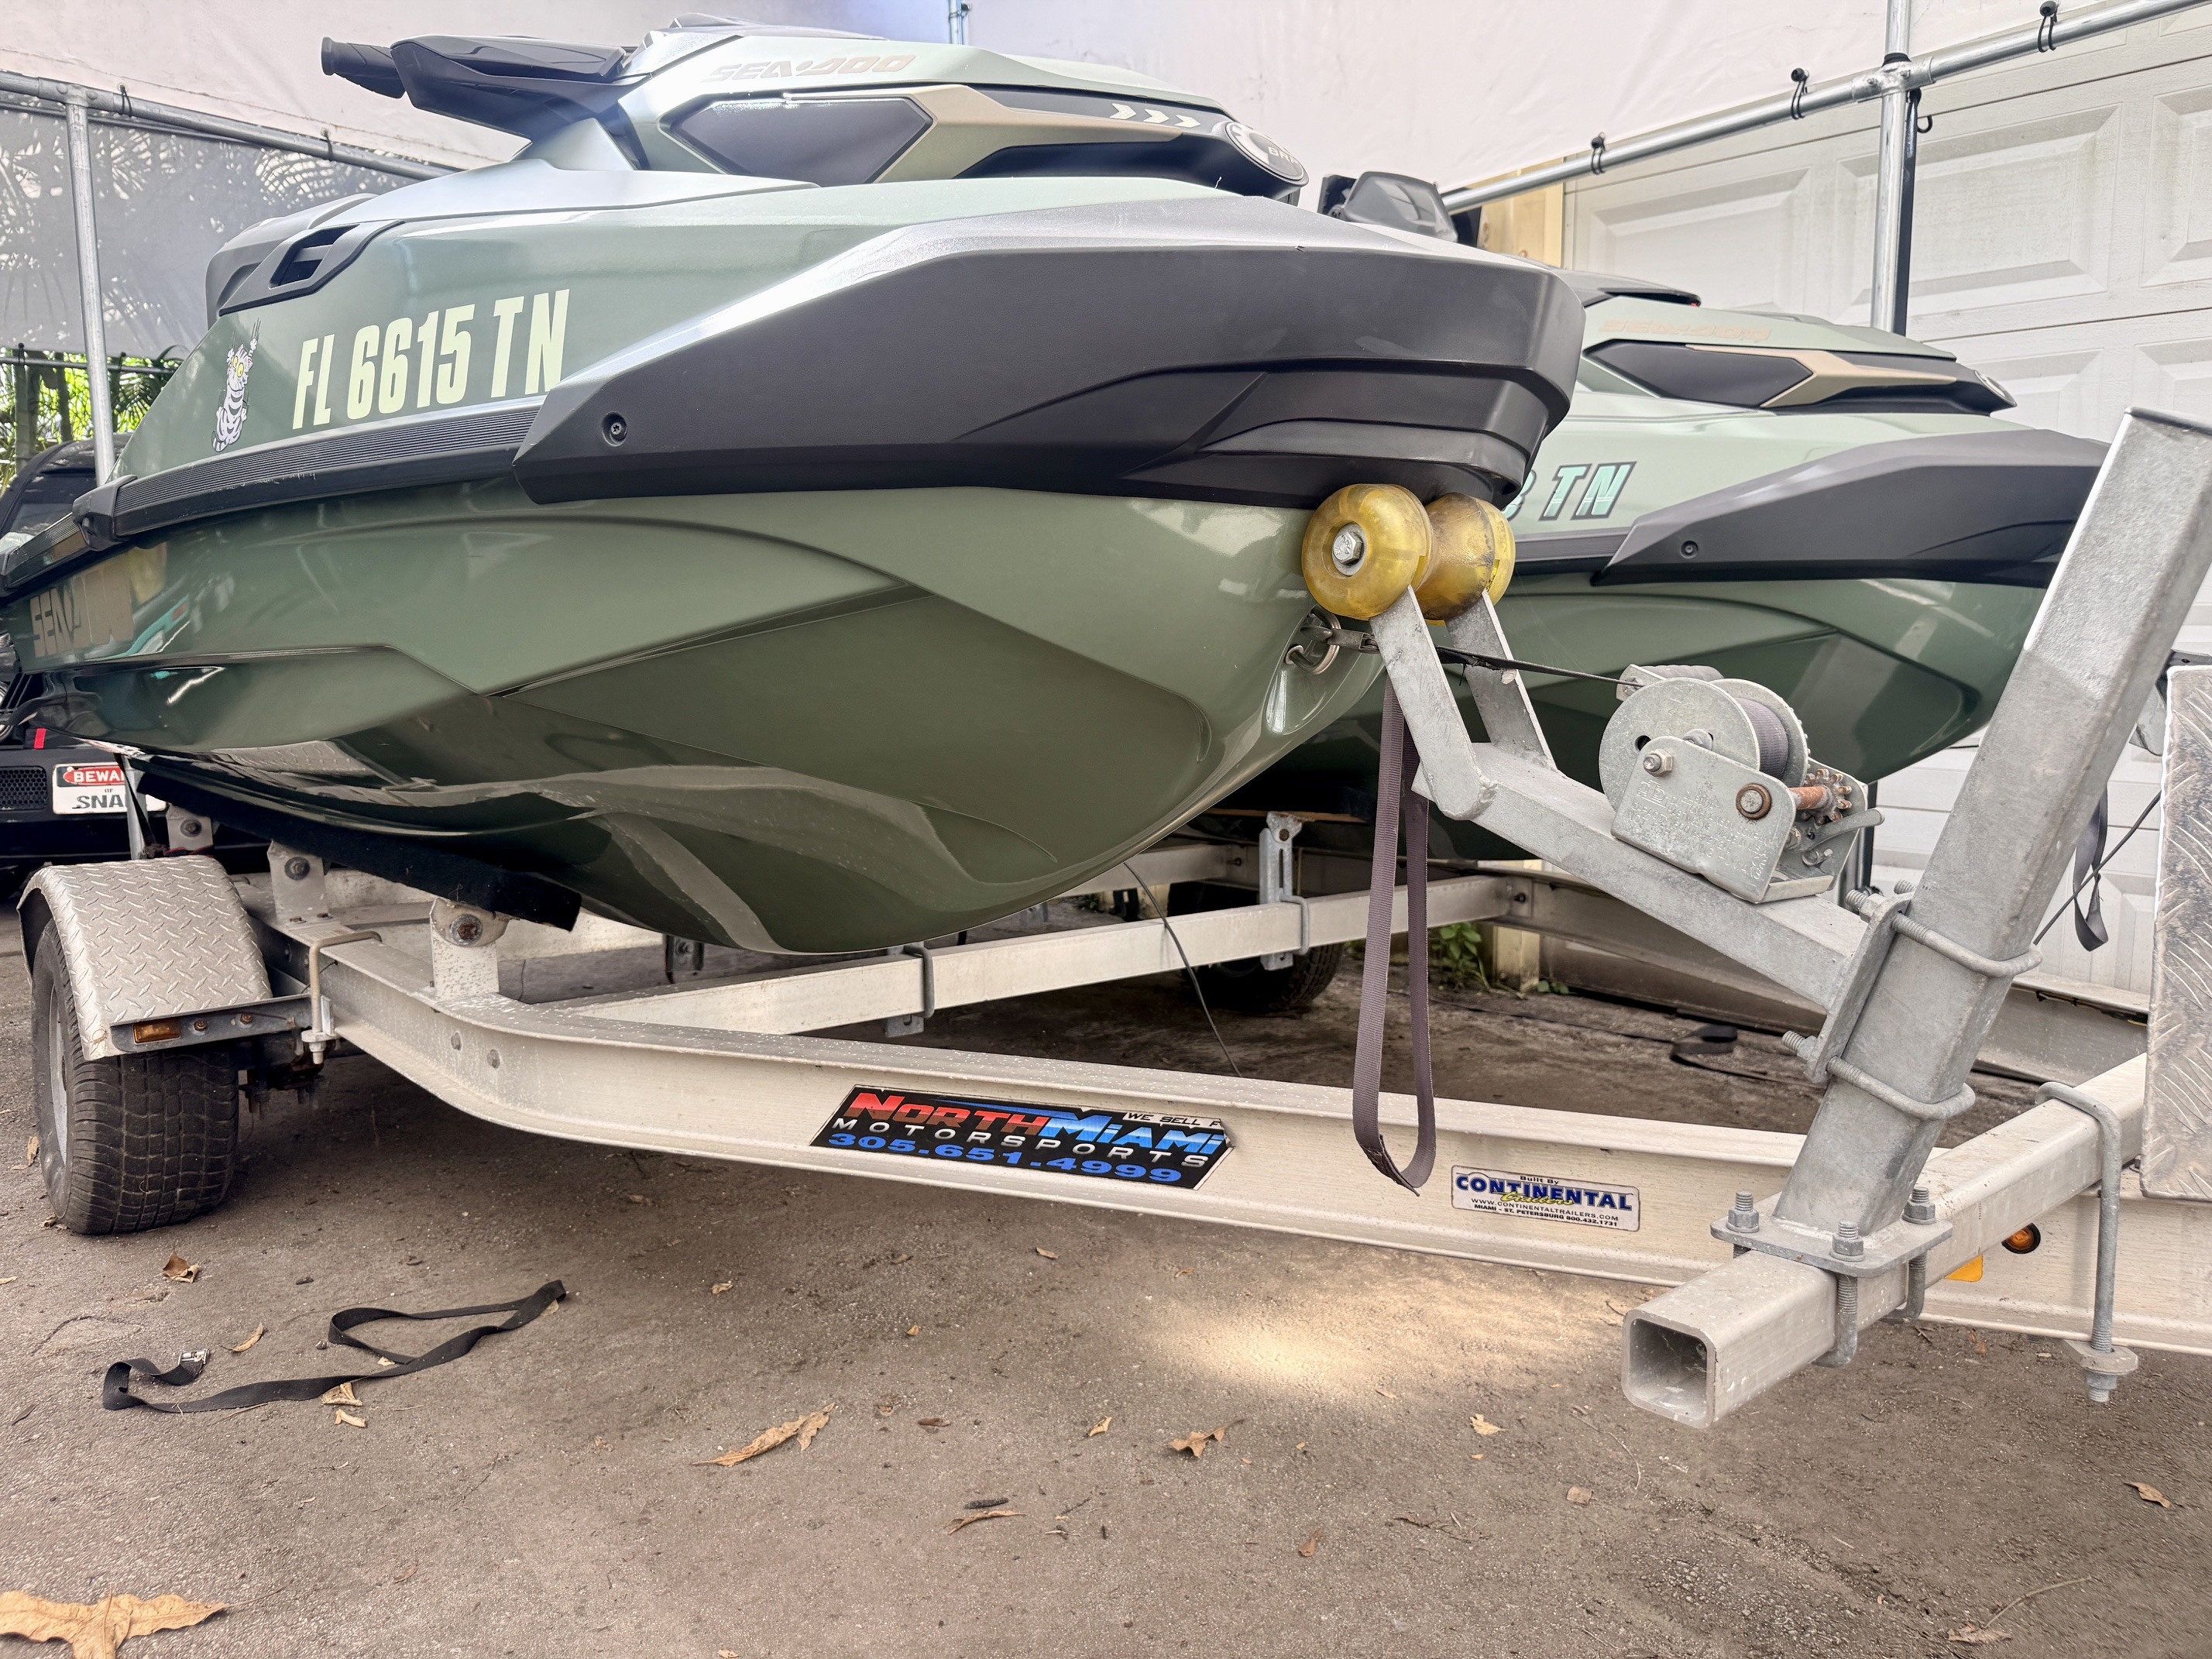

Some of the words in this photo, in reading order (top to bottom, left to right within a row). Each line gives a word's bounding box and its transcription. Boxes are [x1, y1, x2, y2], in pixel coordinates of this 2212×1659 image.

[292, 334, 335, 430] FL
[347, 304, 476, 420] 6615
[490, 289, 570, 398] TN
[1538, 461, 1637, 521] TN
[74, 769, 125, 783] BEWA
[843, 1092, 1049, 1135] NORTH
[1128, 1112, 1153, 1121] WE
[1160, 1116, 1200, 1126] SELL
[828, 1132, 1182, 1183] 305.651.4999
[832, 1118, 1209, 1168] MOTORSPORTS
[1455, 1174, 1632, 1211] CONTINENTAL
[1520, 1175, 1544, 1183] Built
[1471, 1197, 1619, 1221] WWW.CONTINENTALTRAILERS.COM
[1516, 1209, 1565, 1220] PETERSBURG
